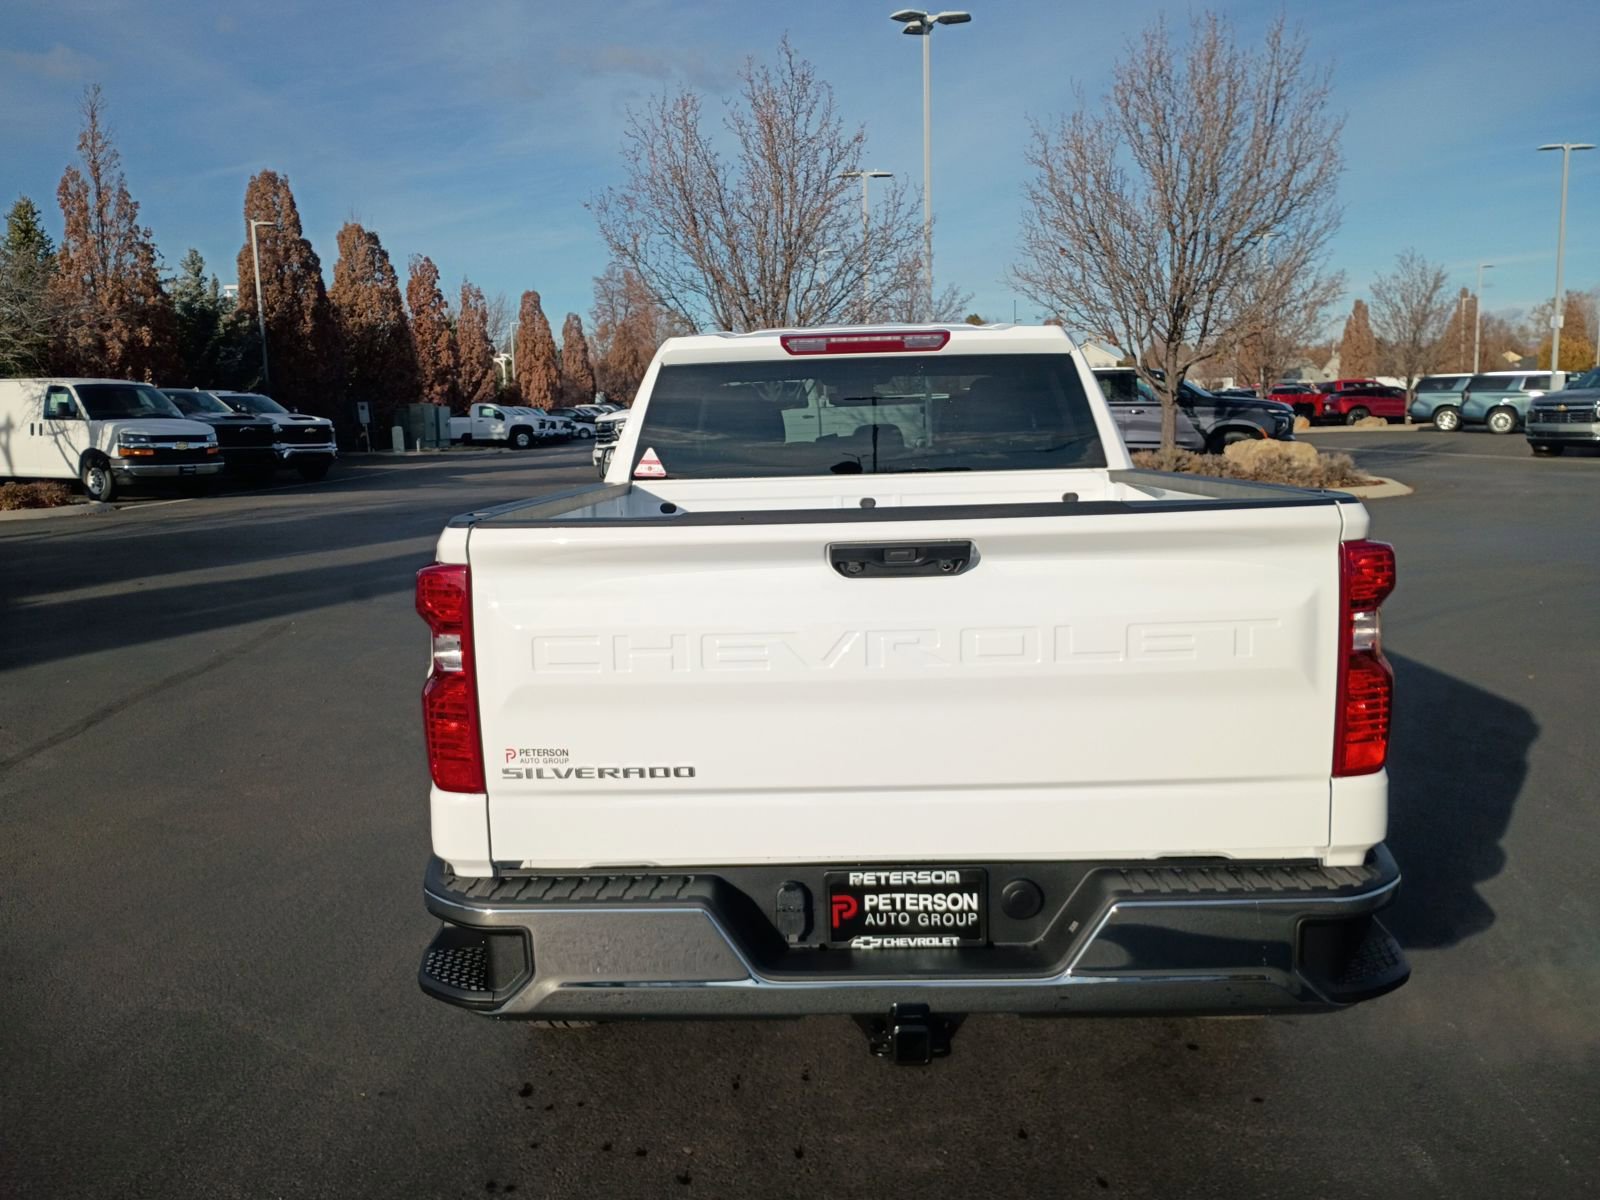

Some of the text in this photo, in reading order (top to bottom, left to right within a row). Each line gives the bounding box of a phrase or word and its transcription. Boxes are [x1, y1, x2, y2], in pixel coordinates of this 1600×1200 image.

[531, 618, 1281, 674] CHEVROLET
[519, 748, 569, 757] PETERSON
[520, 757, 570, 765] AUTO GROUP
[501, 766, 696, 780] SILVERADO
[849, 870, 960, 887] PETERSON
[864, 892, 978, 912] PETERSON
[865, 912, 978, 927] AUTO GROUP
[883, 936, 960, 948] CHEVROLET
